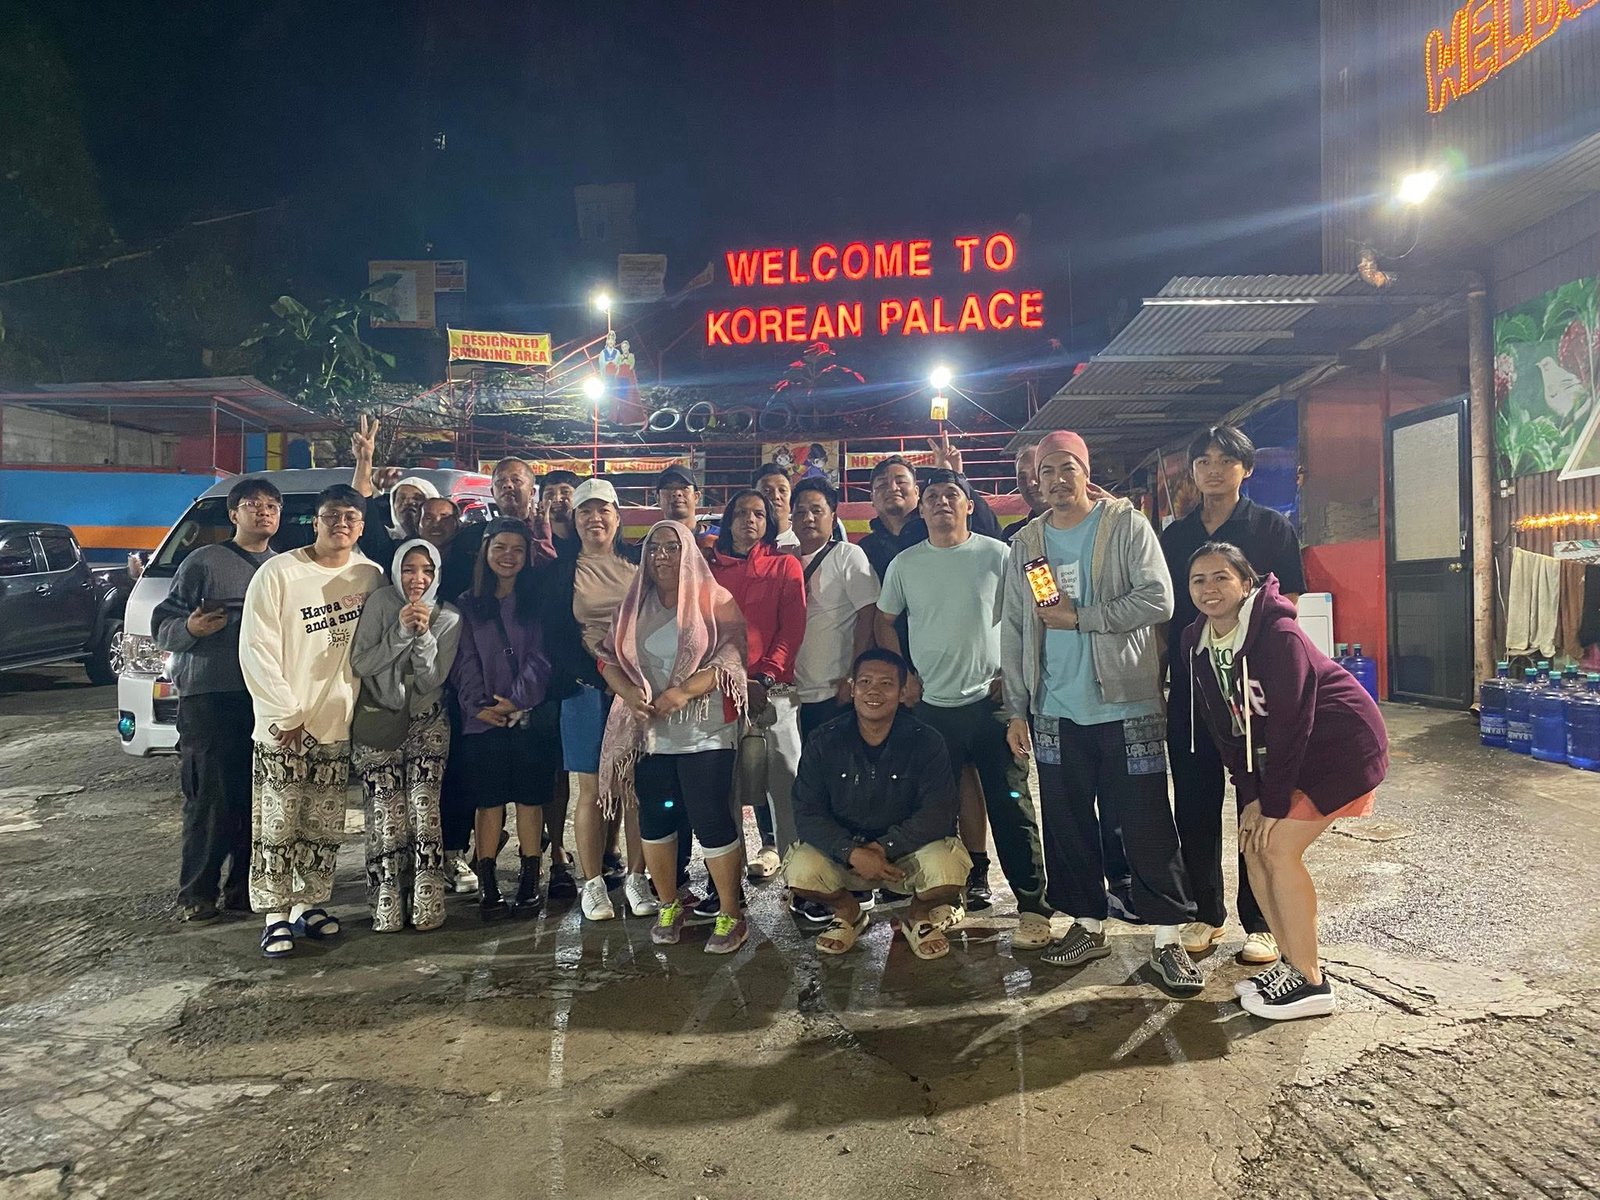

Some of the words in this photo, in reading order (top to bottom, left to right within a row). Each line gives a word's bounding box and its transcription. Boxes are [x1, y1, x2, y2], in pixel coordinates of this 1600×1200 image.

[726, 240, 932, 286] WELCOME
[955, 232, 1015, 273] TO
[707, 302, 862, 345] KOREAN
[879, 290, 1044, 336] PALACE
[462, 334, 539, 348] DESIGNATED
[451, 347, 512, 361] SMOKING
[515, 350, 547, 362] AREA
[851, 456, 869, 467] NO
[300, 603, 333, 620] Have
[333, 601, 342, 611] a
[305, 617, 329, 633] and
[329, 616, 337, 627] a
[338, 604, 363, 624] smi
